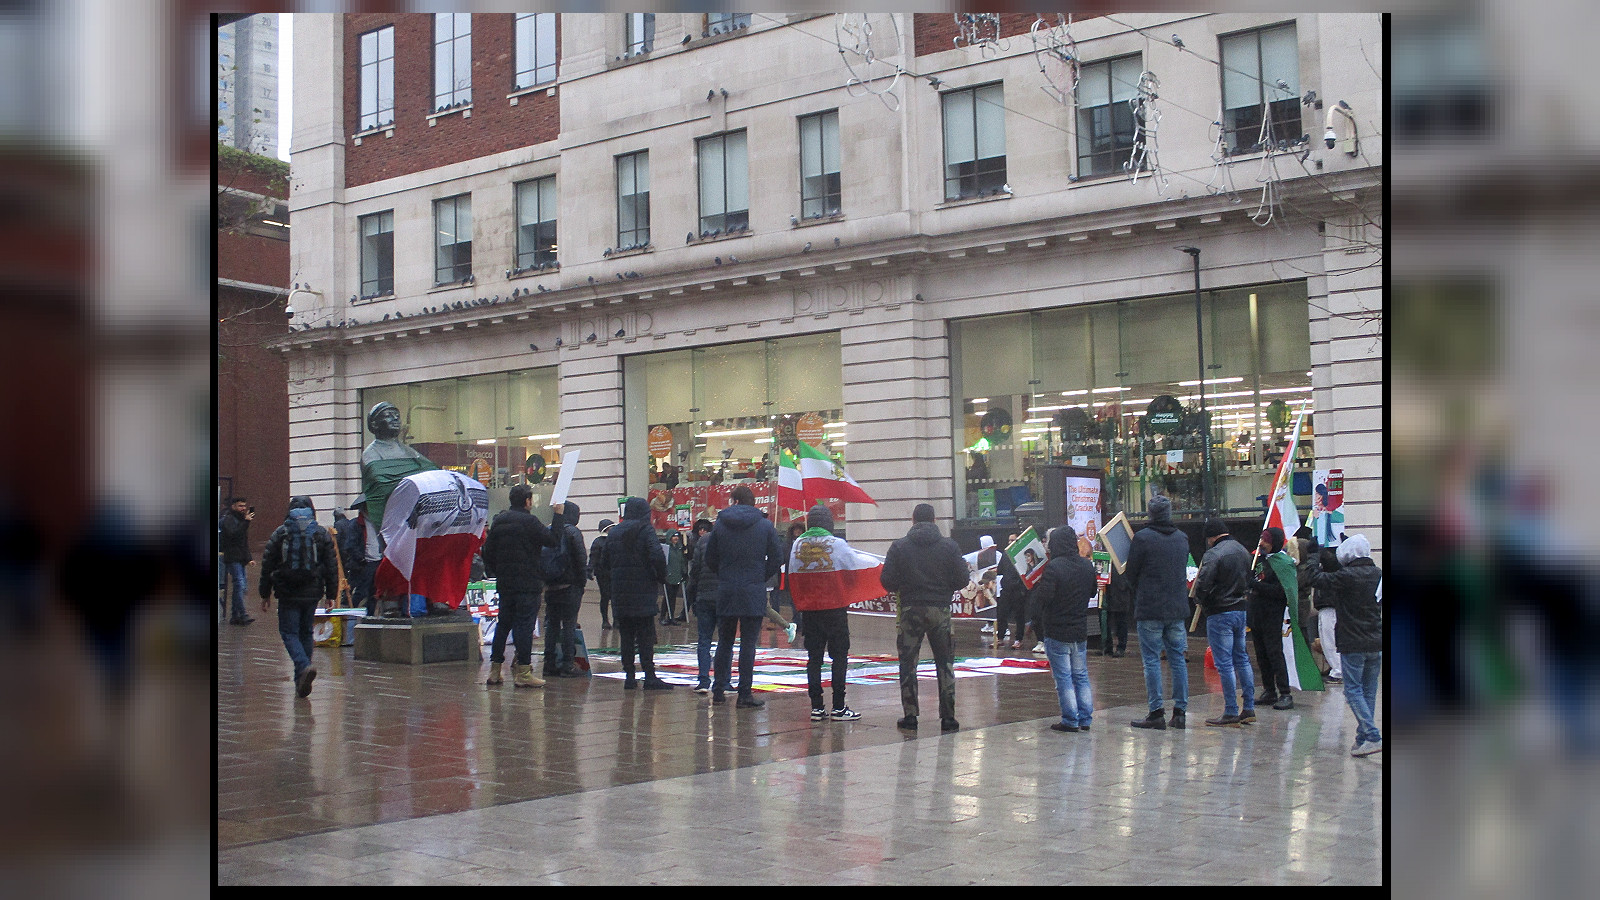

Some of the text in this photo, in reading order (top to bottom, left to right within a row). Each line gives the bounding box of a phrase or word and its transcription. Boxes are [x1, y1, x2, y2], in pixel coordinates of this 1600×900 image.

[465, 449, 493, 459] Tobacco
[1328, 480, 1343, 489] LIFE
[1068, 485, 1099, 495] The Ultimate
[1071, 494, 1097, 503] Christmas
[1074, 504, 1094, 512] Cracker
